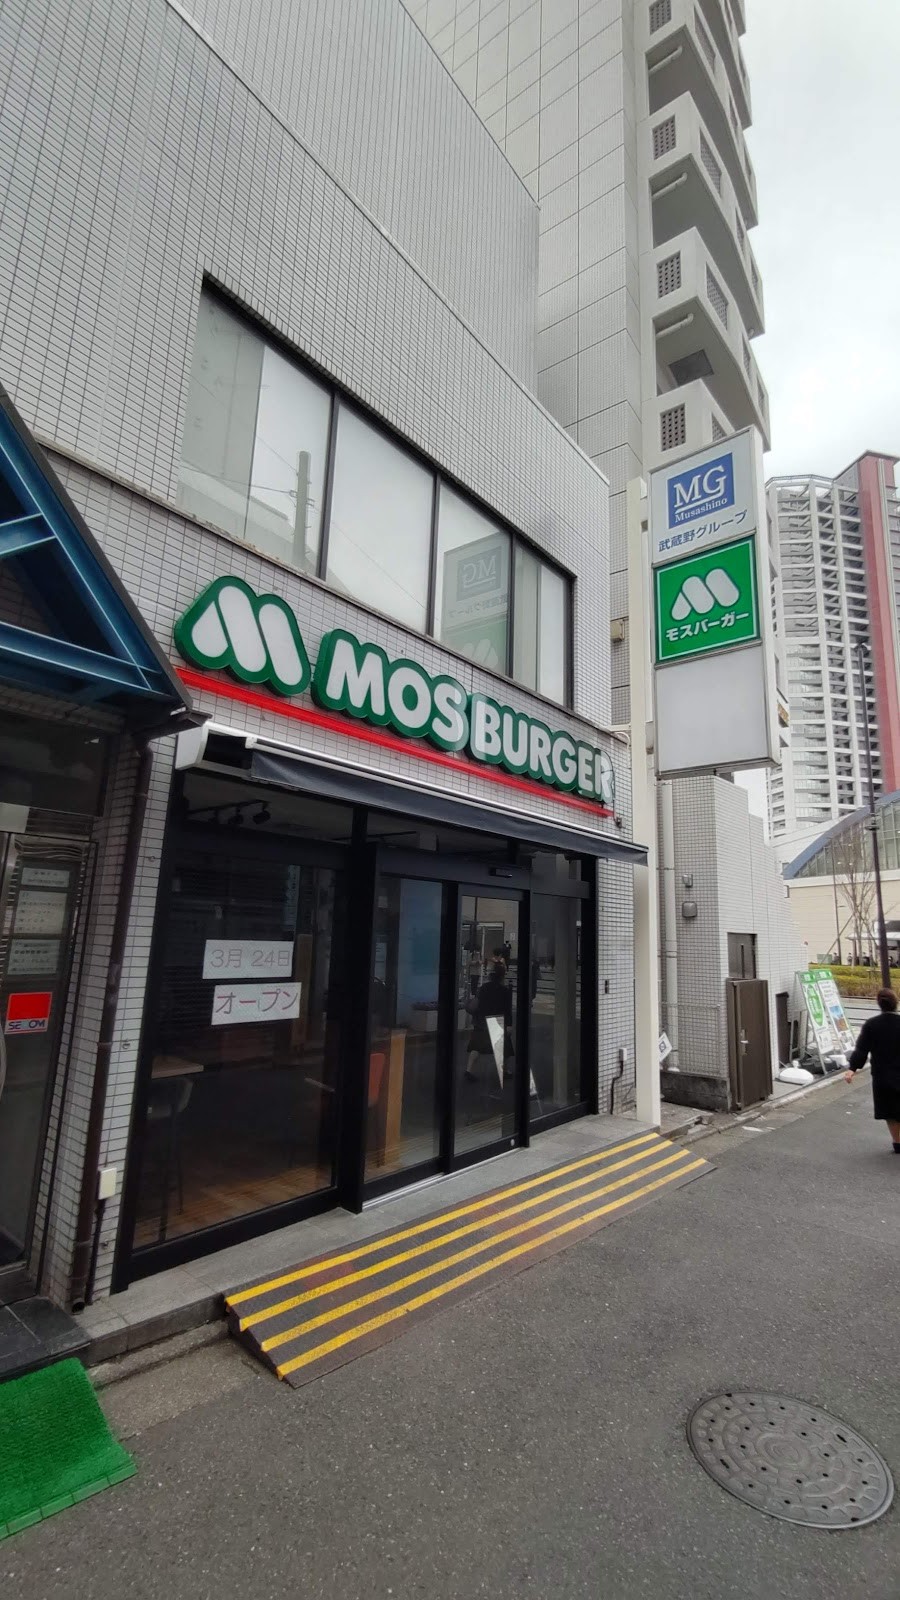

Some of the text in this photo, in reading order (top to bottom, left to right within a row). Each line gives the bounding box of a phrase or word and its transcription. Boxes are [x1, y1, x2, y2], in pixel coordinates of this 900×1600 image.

[673, 465, 727, 512] MG
[674, 497, 728, 523] Musashino
[658, 510, 748, 553] 武蔵野グループ
[665, 611, 750, 642] モスバーガー
[325, 638, 613, 799] MOS BURGER
[210, 948, 290, 969] 3月 24日
[215, 988, 299, 1015] オープン
[8, 1019, 46, 1030] SEOM
